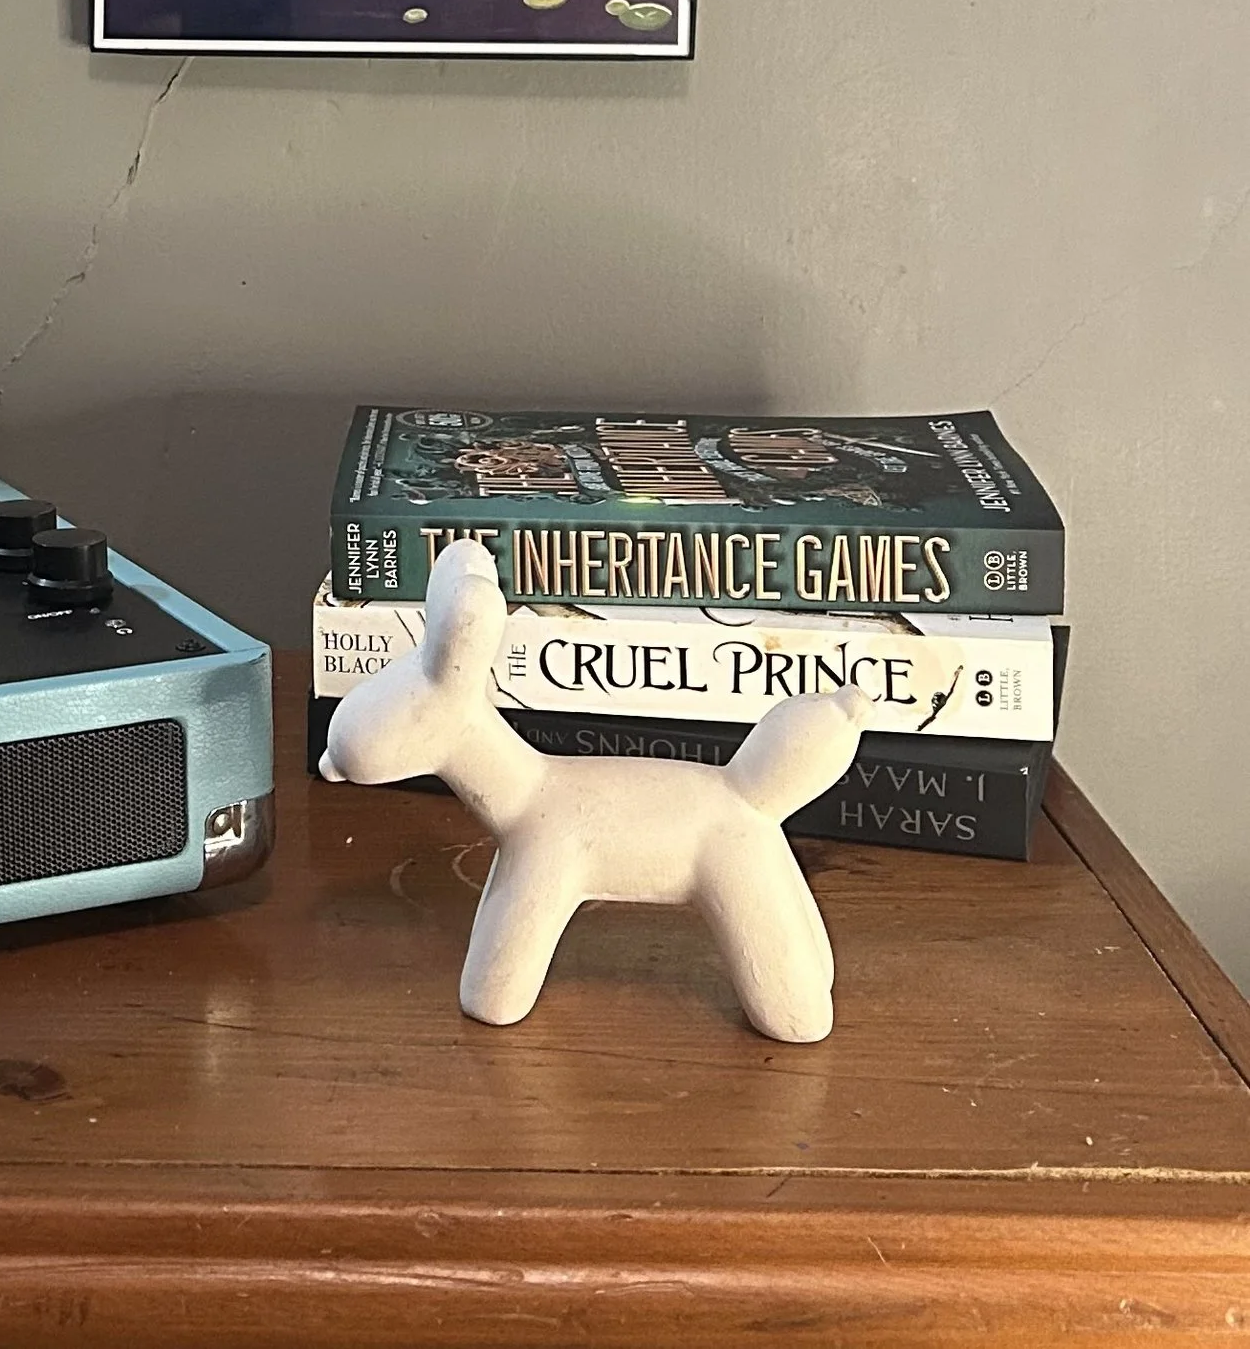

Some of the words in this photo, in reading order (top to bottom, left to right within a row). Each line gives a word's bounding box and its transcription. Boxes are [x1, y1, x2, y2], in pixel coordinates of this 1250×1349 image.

[928, 420, 968, 449] BARNES
[596, 418, 727, 499] INHERITANCE
[946, 450, 983, 467] LYNN
[476, 472, 580, 497] THE
[961, 469, 1010, 512] JENNIFER
[346, 523, 362, 594] JENNIFER
[365, 538, 380, 579] LYNN
[383, 529, 398, 589] BARNES
[513, 529, 781, 600] INHERITANCE
[796, 534, 951, 603] GAMES
[1018, 550, 1028, 591] BROWN
[324, 633, 393, 652] HOLLY
[507, 644, 526, 681] THE
[539, 639, 708, 695] CRUEL
[713, 640, 917, 704] PRINCE
[1013, 669, 1022, 711] BROWN
[526, 728, 569, 746] AND
[840, 801, 977, 840] SARAH
